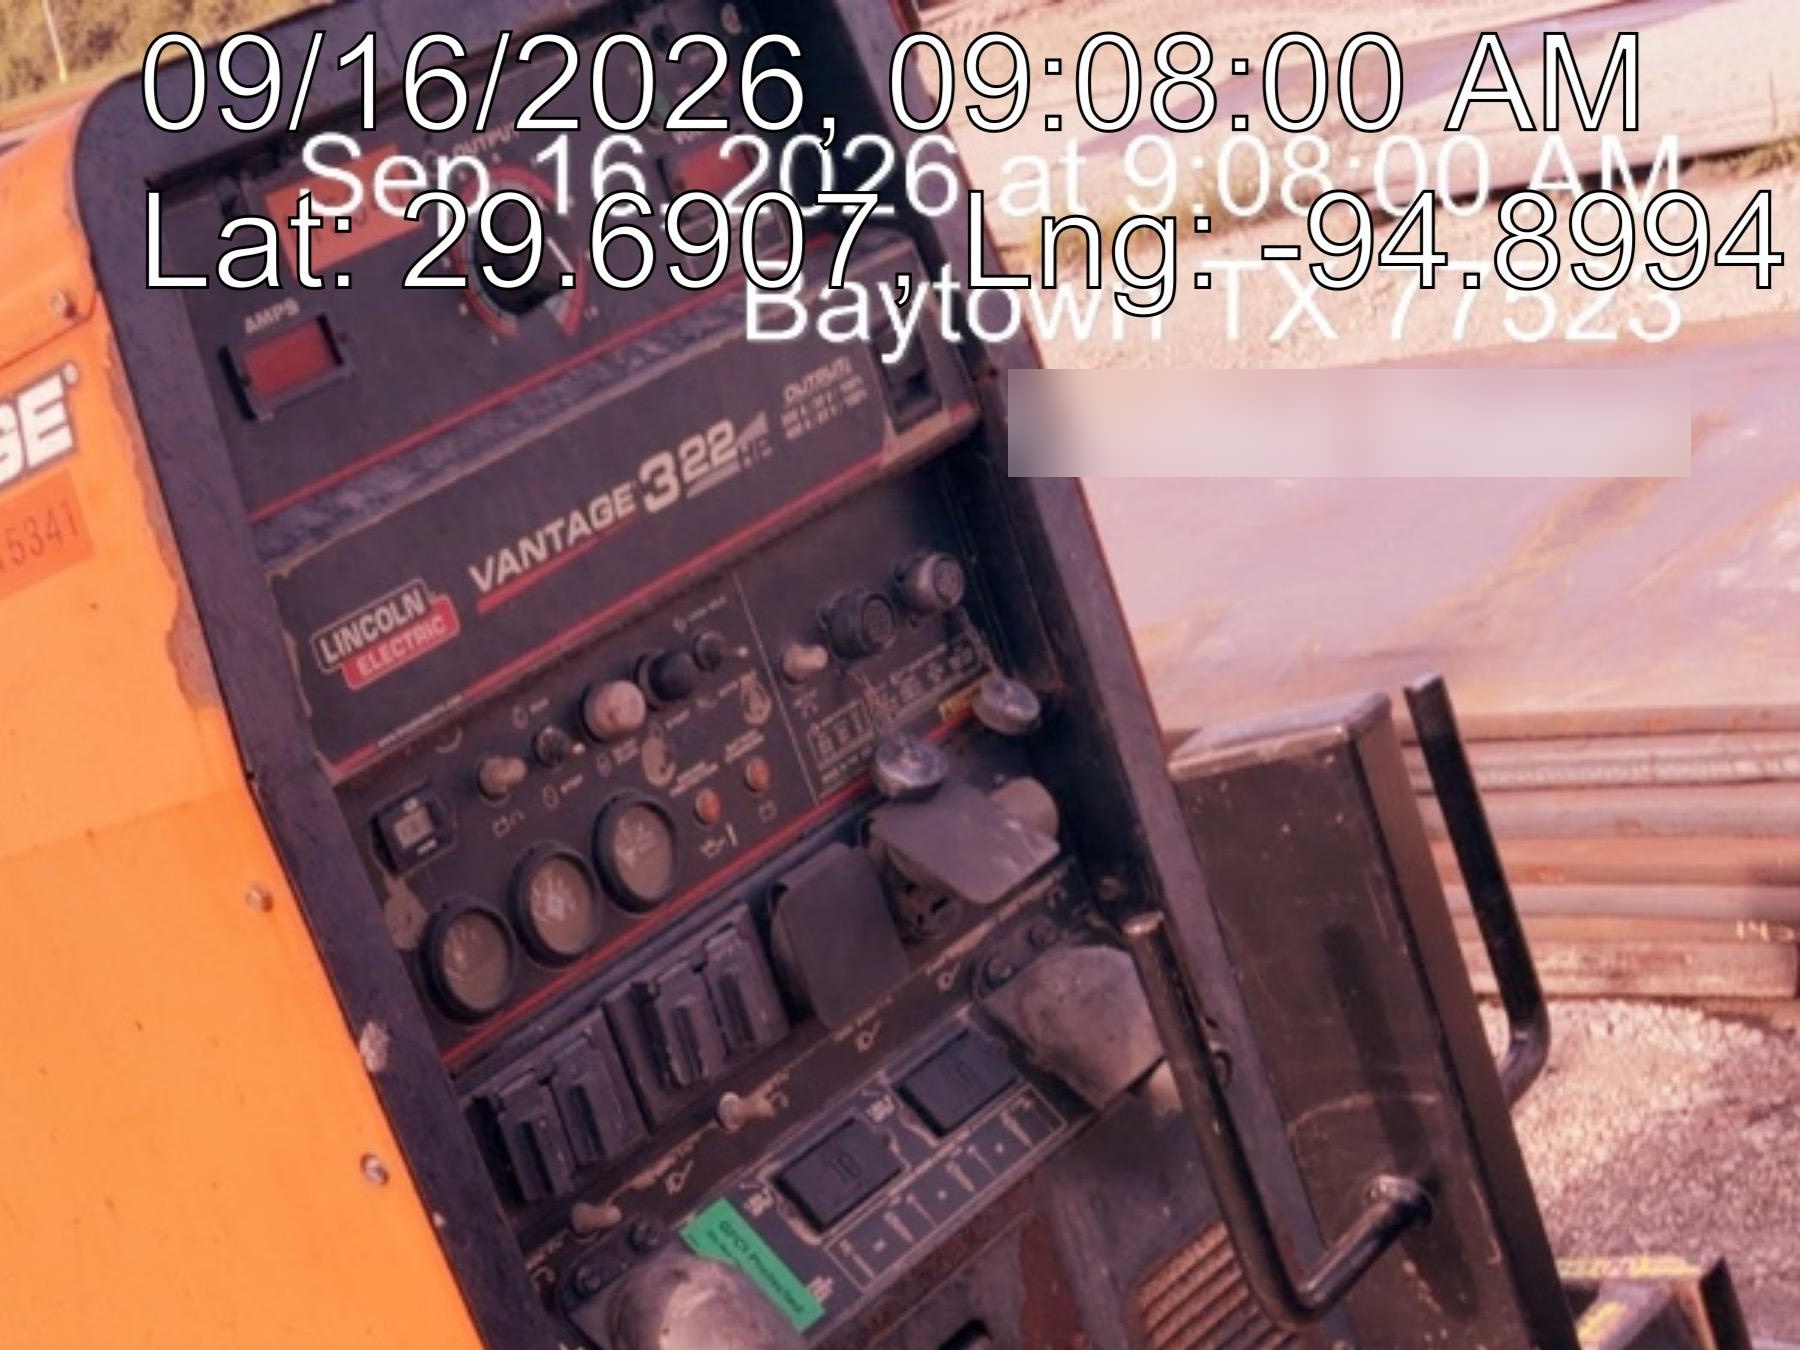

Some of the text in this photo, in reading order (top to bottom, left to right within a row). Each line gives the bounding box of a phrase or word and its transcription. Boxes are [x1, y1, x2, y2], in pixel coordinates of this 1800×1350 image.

[467, 418, 736, 595] VANTAGE 322
[317, 588, 427, 665] LINCOLN
[357, 615, 450, 679] ELECTRIC
